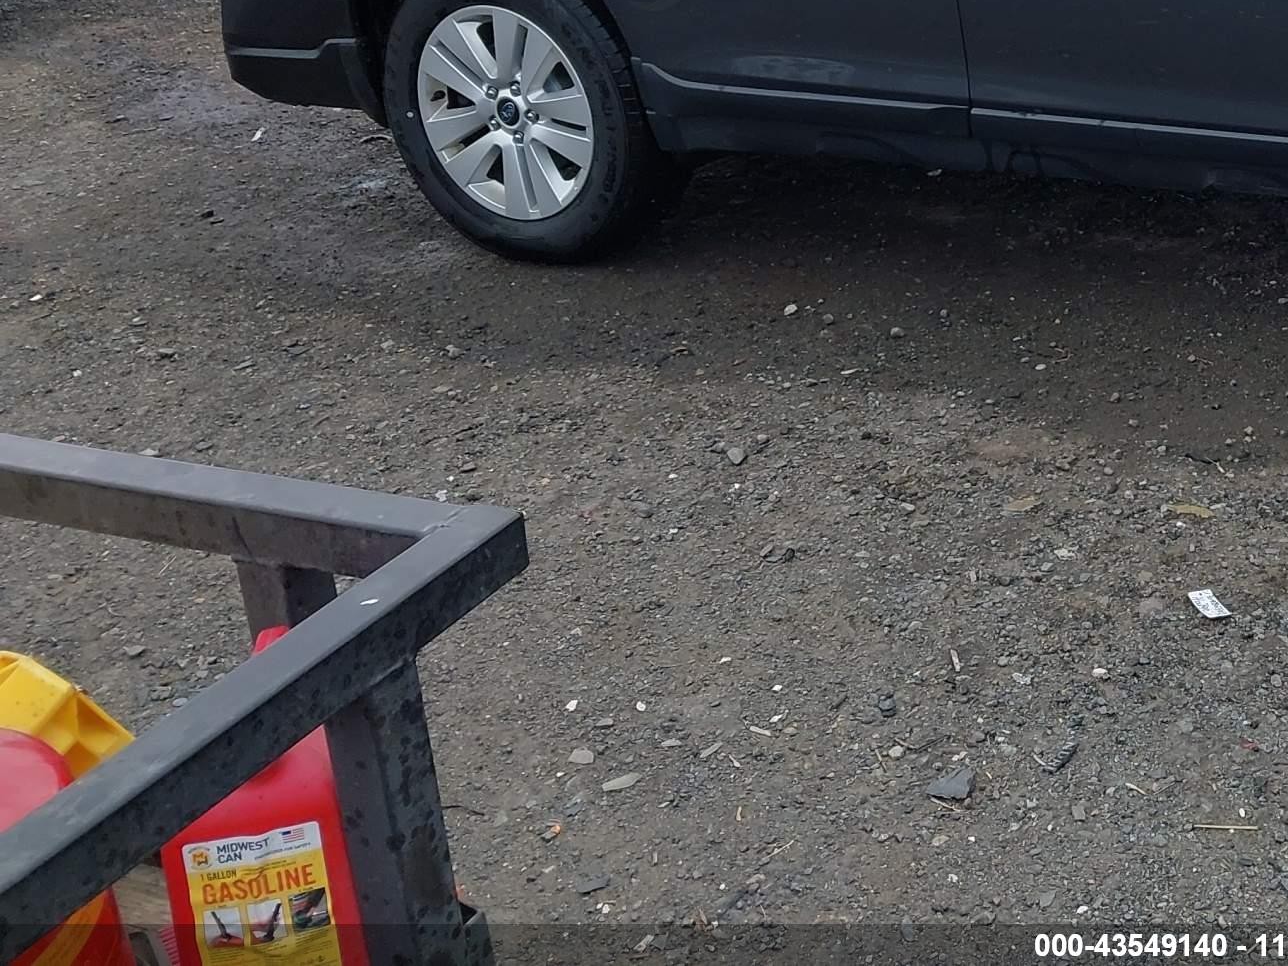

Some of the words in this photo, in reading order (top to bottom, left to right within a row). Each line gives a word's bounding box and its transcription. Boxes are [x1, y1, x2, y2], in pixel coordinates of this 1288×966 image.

[216, 838, 270, 853] MIDWEST
[217, 853, 242, 864] CAN
[206, 869, 237, 881] GALLON
[203, 864, 316, 905] GASOLINE
